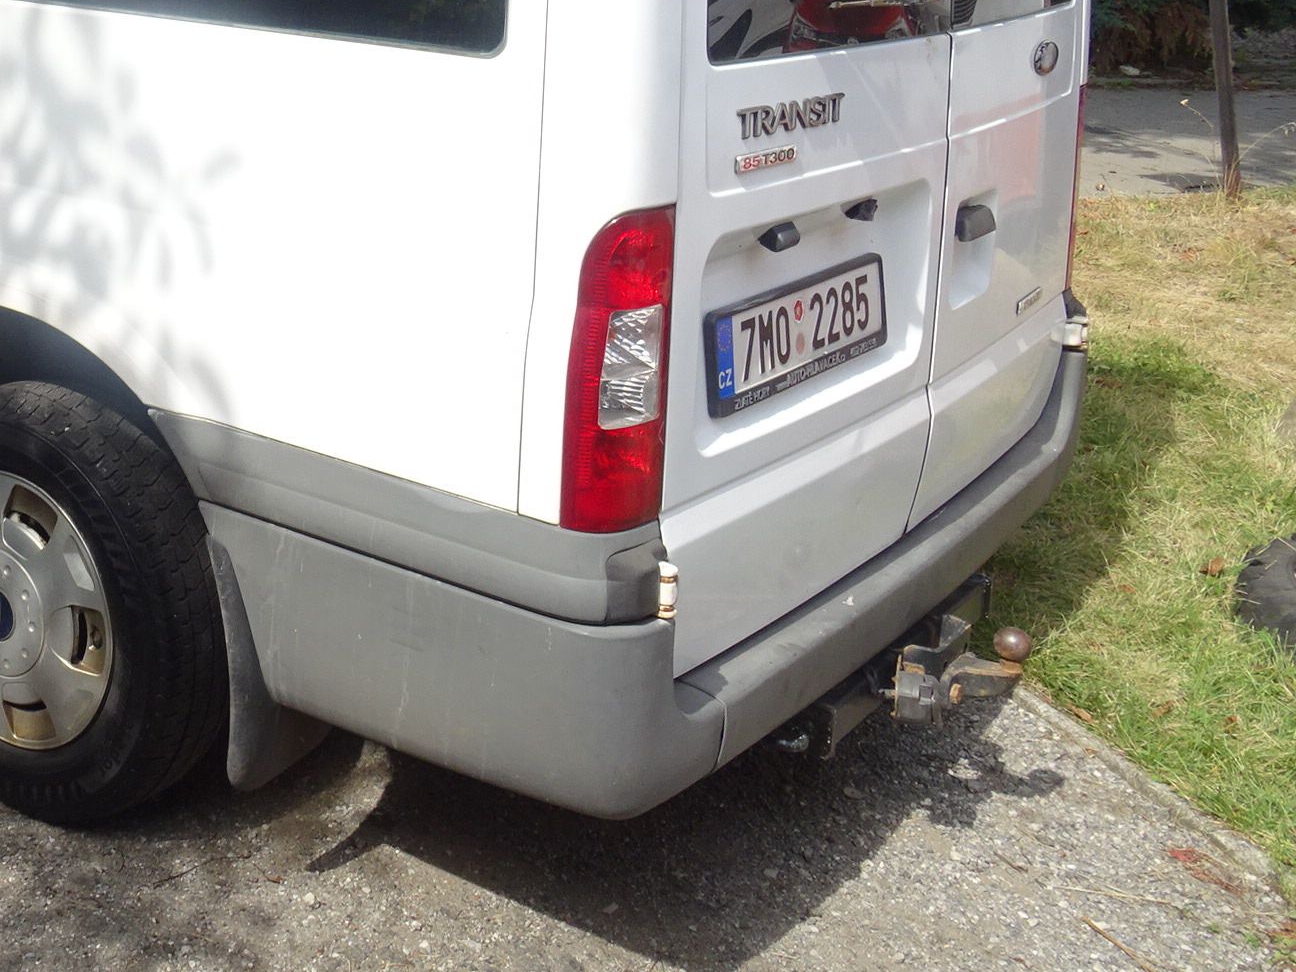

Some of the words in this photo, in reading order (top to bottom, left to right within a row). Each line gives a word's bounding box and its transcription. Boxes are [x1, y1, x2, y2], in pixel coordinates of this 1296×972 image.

[736, 92, 846, 141] TRANSIT
[809, 274, 870, 350] 2285
[718, 368, 733, 389] CZ
